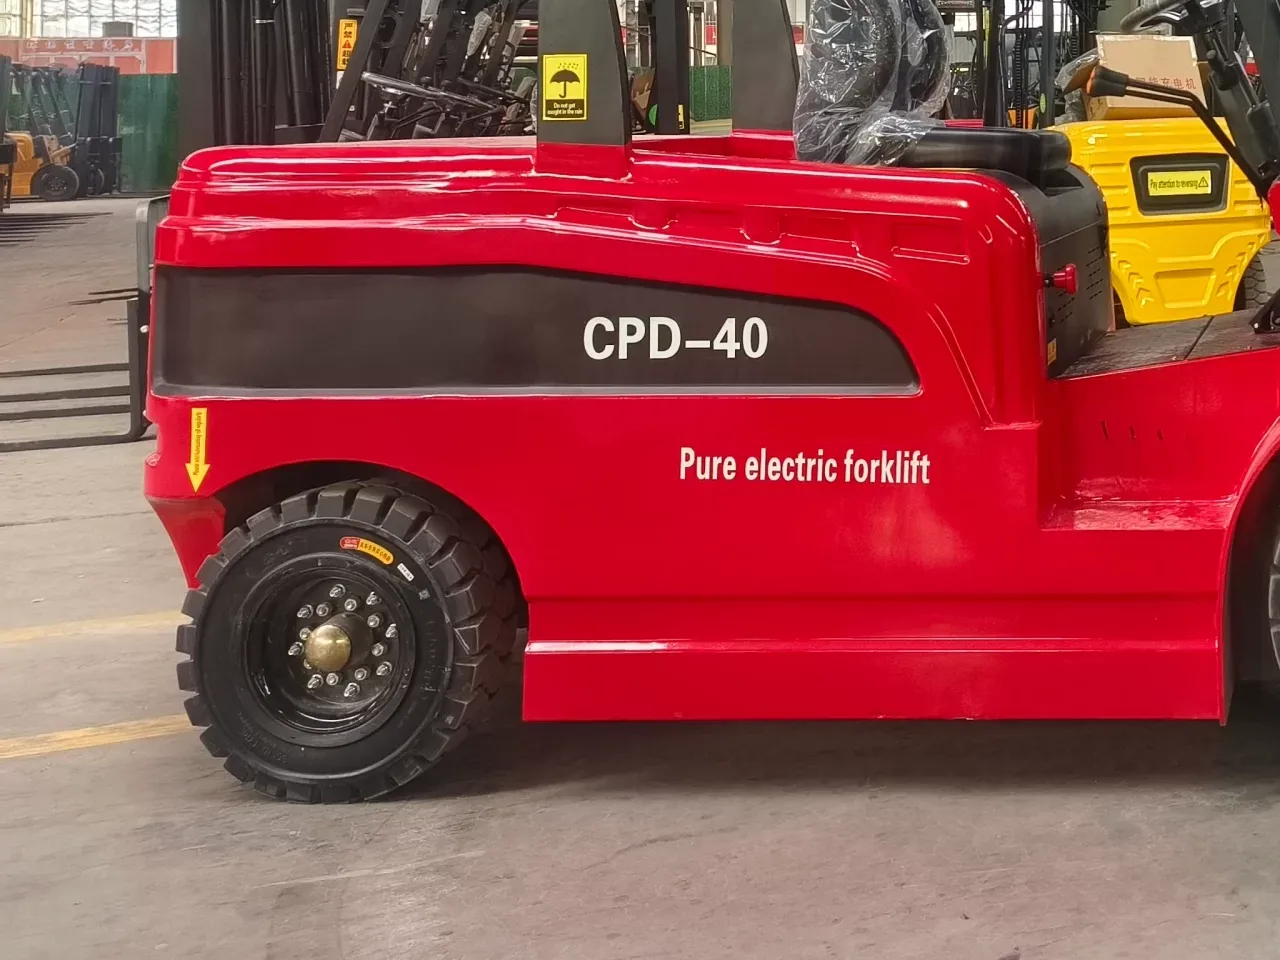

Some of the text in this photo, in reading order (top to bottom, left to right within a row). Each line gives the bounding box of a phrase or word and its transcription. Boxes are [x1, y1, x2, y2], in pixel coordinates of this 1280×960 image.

[583, 316, 769, 360] CPD-40
[679, 446, 931, 485] Pure electric forklift
